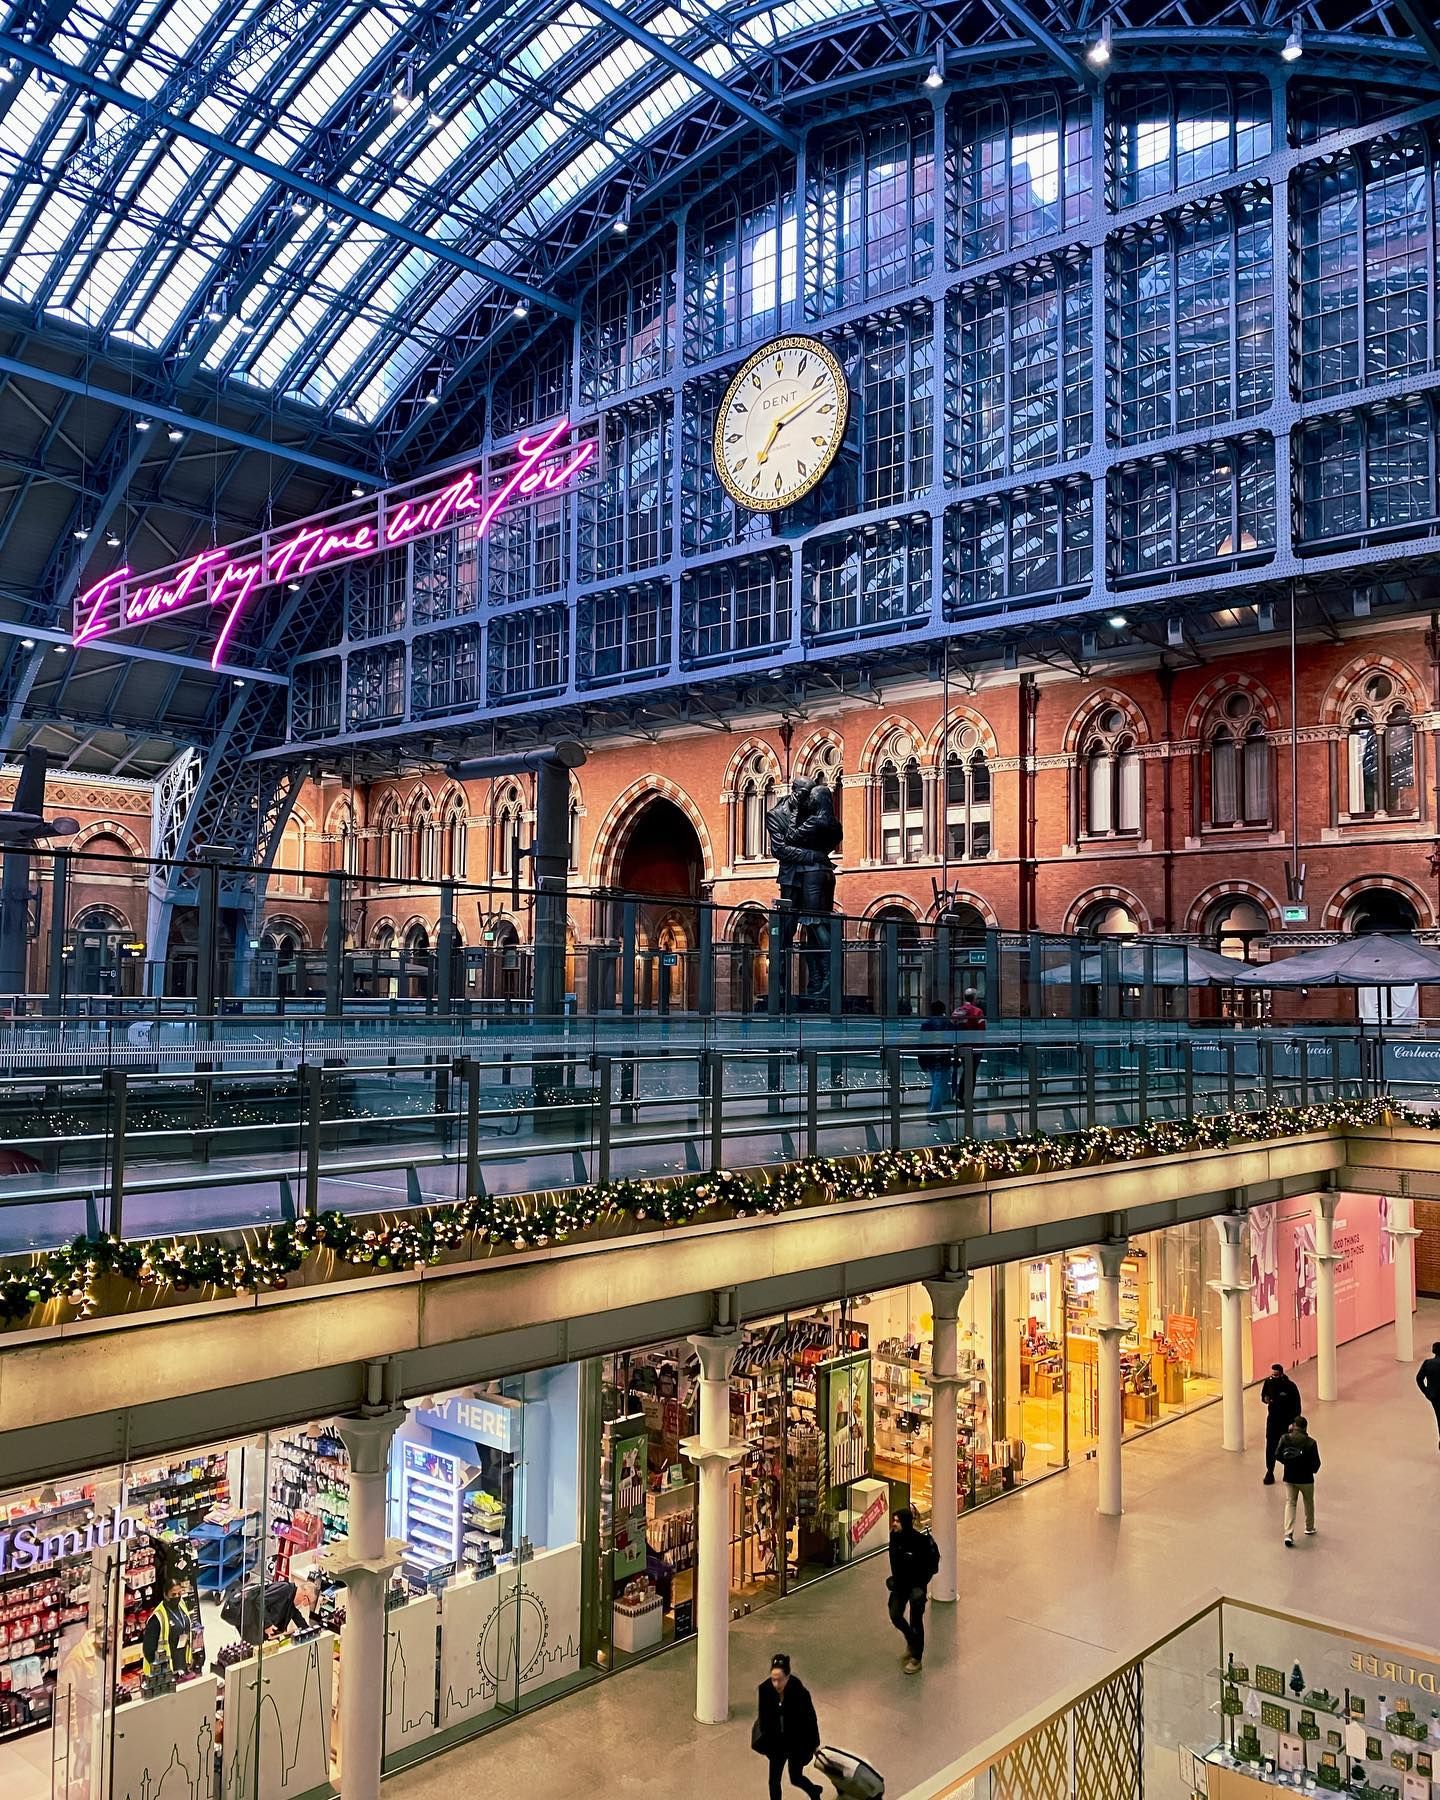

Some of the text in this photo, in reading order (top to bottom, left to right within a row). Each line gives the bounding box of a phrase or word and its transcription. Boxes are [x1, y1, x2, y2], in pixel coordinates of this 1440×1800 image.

[762, 390, 798, 411] DENT
[72, 566, 129, 648] I
[126, 548, 226, 622] want
[209, 562, 262, 672] my
[267, 526, 374, 582] time
[386, 472, 481, 541] with
[1393, 1045, 1440, 1059] Carlucci
[418, 1400, 508, 1440] AY HERE
